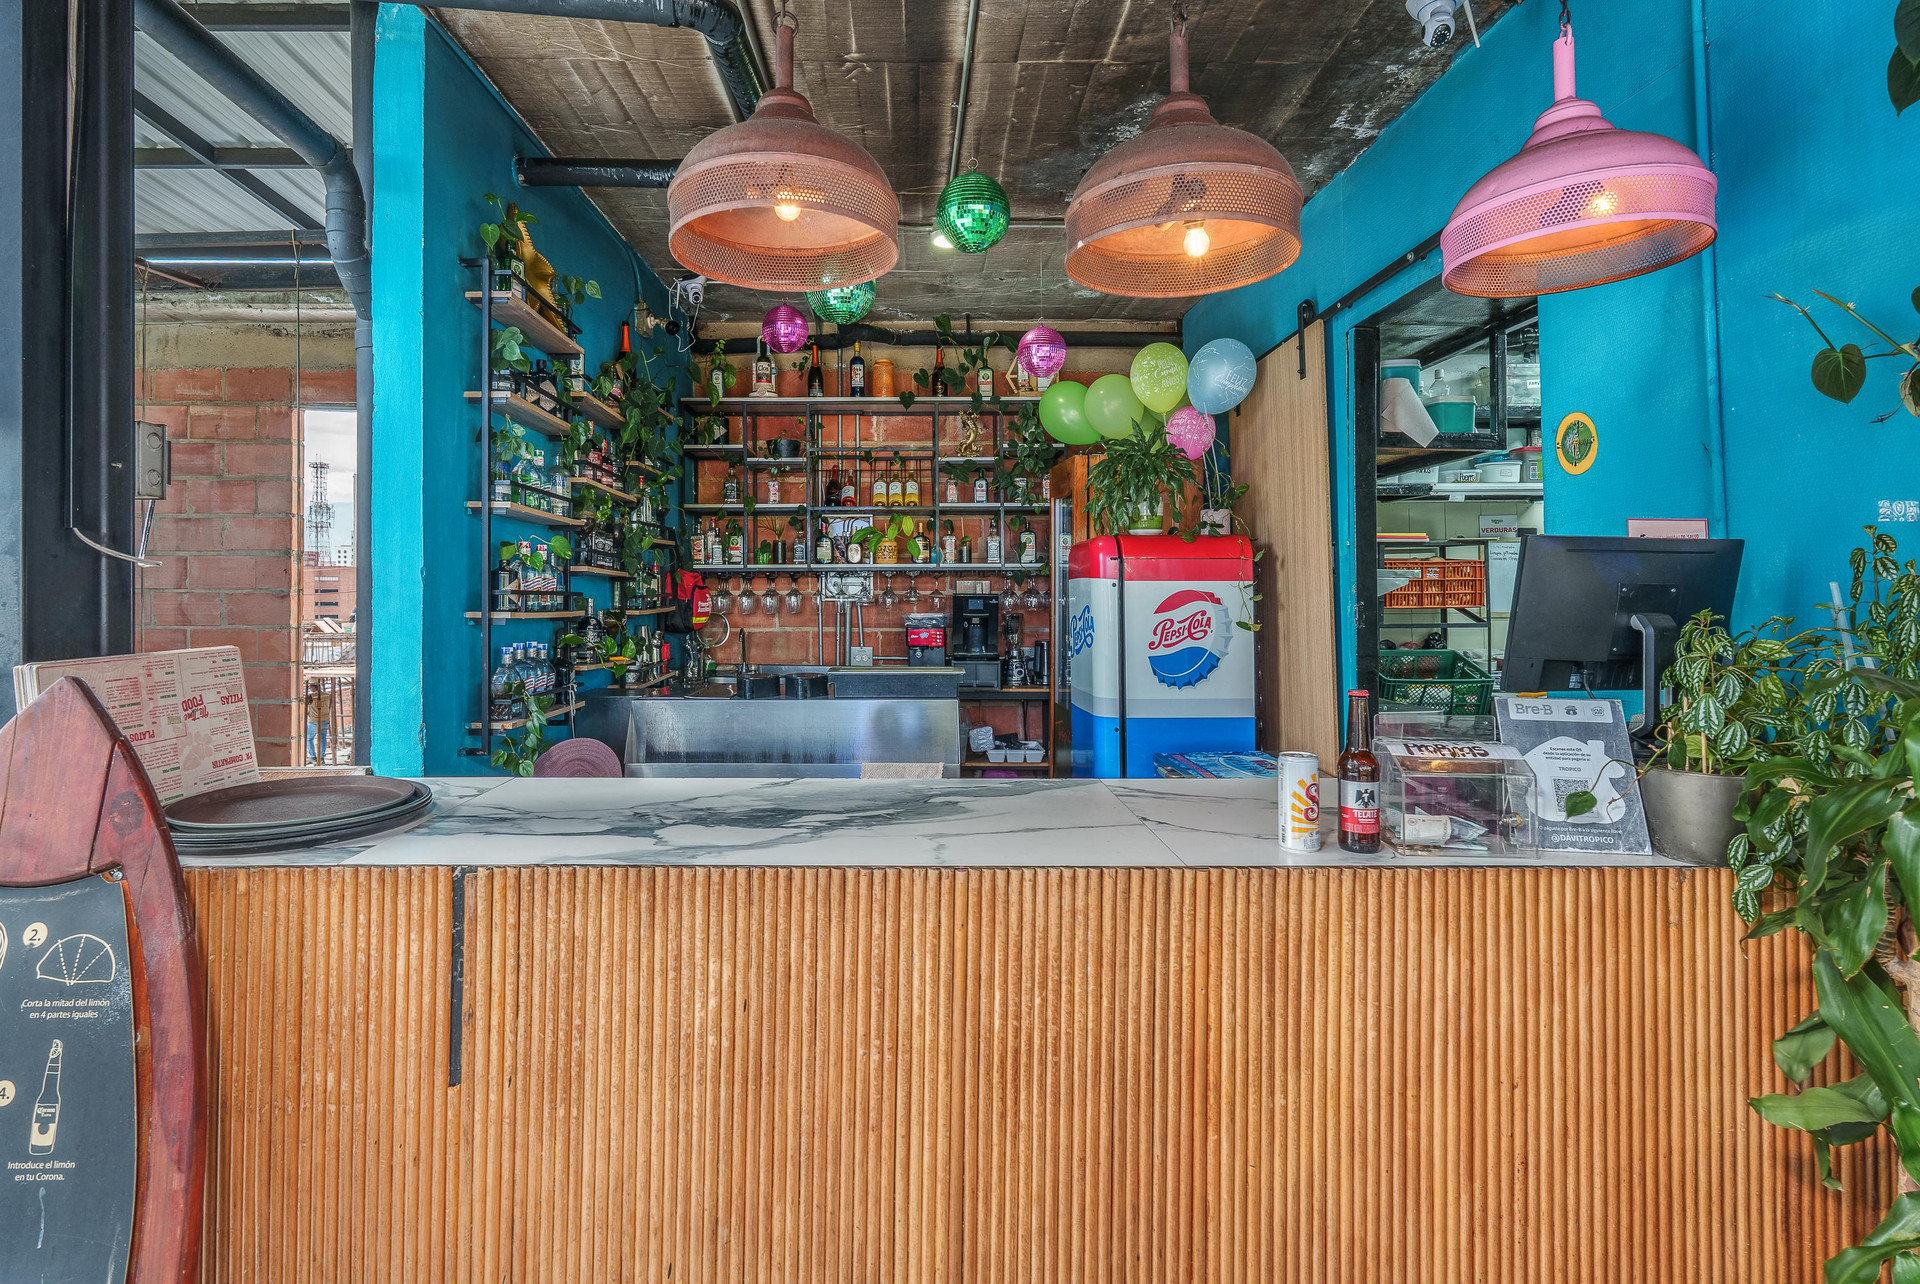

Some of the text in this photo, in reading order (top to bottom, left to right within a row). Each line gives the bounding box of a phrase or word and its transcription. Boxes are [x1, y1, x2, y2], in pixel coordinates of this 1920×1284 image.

[1226, 369, 1248, 388] FELIZ
[181, 694, 204, 711] FOOD
[221, 693, 244, 706] PIZZAS
[1514, 703, 1554, 715] Bre-B
[129, 730, 155, 742] PLATOS
[211, 754, 244, 769] COMPARTIR
[1353, 809, 1378, 819] TECATE
[1551, 833, 1614, 844] @DAVITROPICO
[29, 929, 41, 942] 2.
[22, 998, 110, 1007] Corta la mitad del limón
[46, 1011, 71, 1019] partes
[71, 1010, 99, 1019] iguales
[7, 1160, 76, 1169] Introduce el limón
[26, 1173, 35, 1181] tu
[35, 1172, 65, 1181] Corona.
